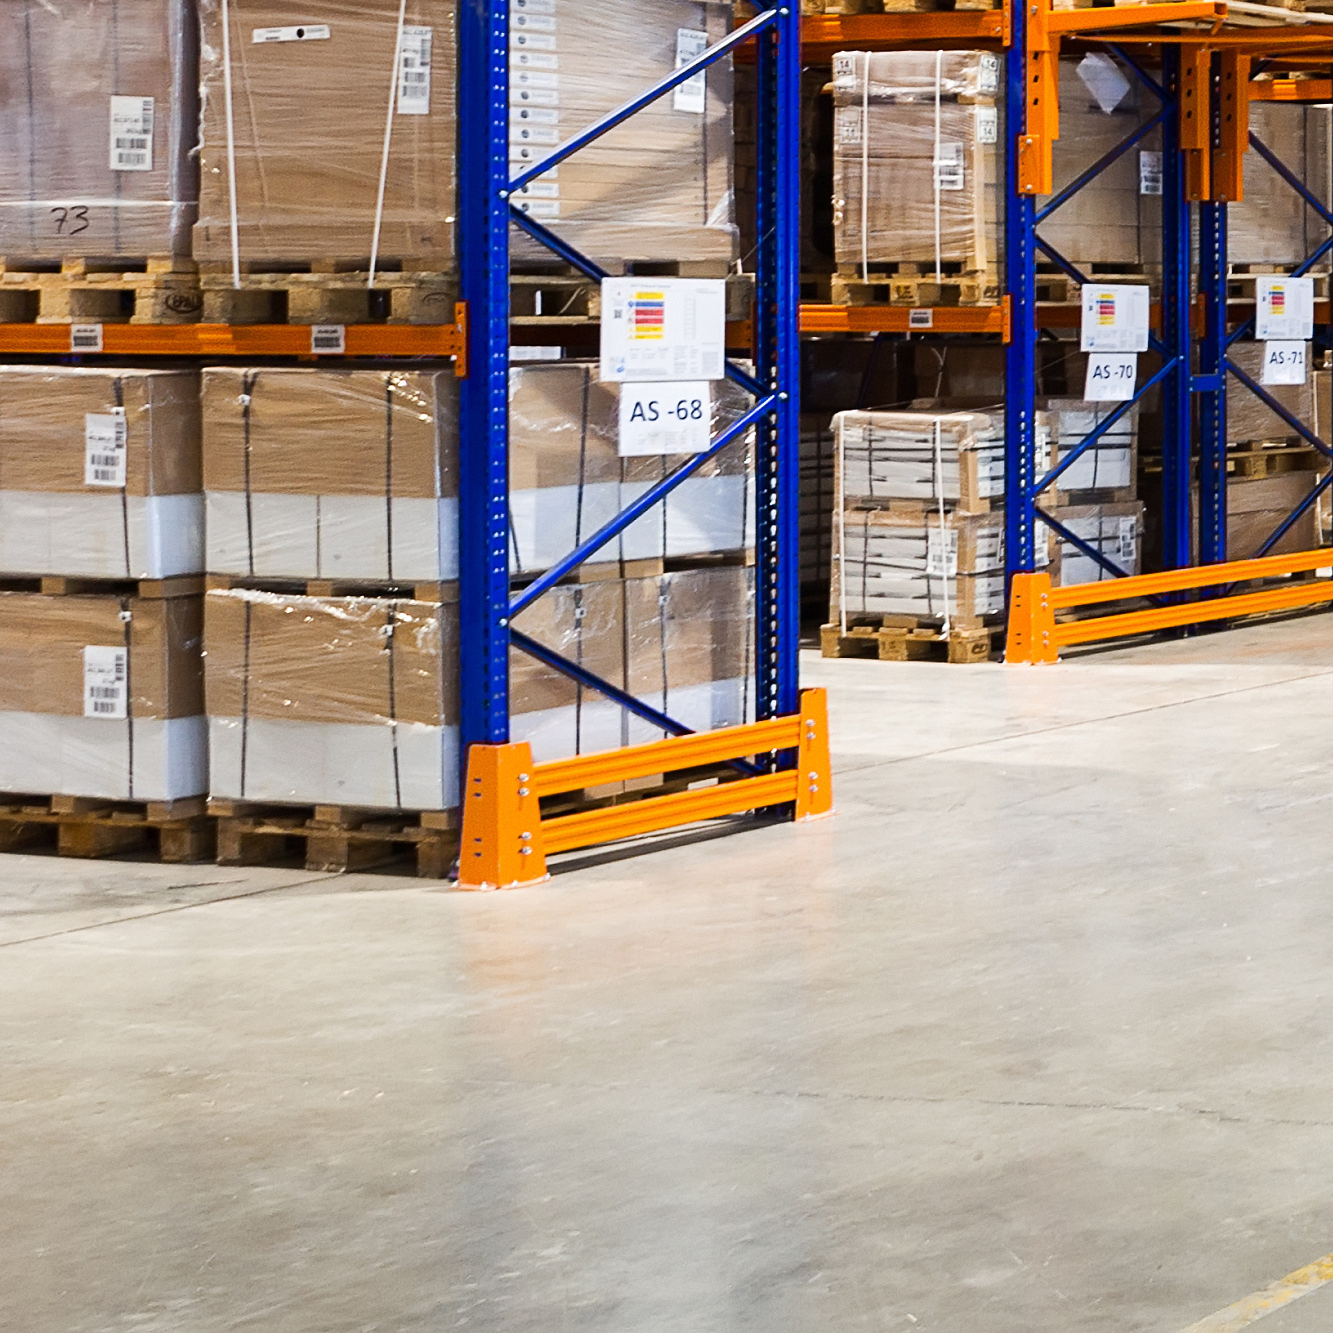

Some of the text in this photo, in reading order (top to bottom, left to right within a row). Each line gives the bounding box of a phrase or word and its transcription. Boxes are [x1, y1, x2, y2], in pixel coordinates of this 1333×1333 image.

[51, 205, 89, 235] 73
[1269, 351, 1304, 365] AS -71
[1092, 364, 1133, 379] AS -70
[629, 399, 703, 422] AS -68
